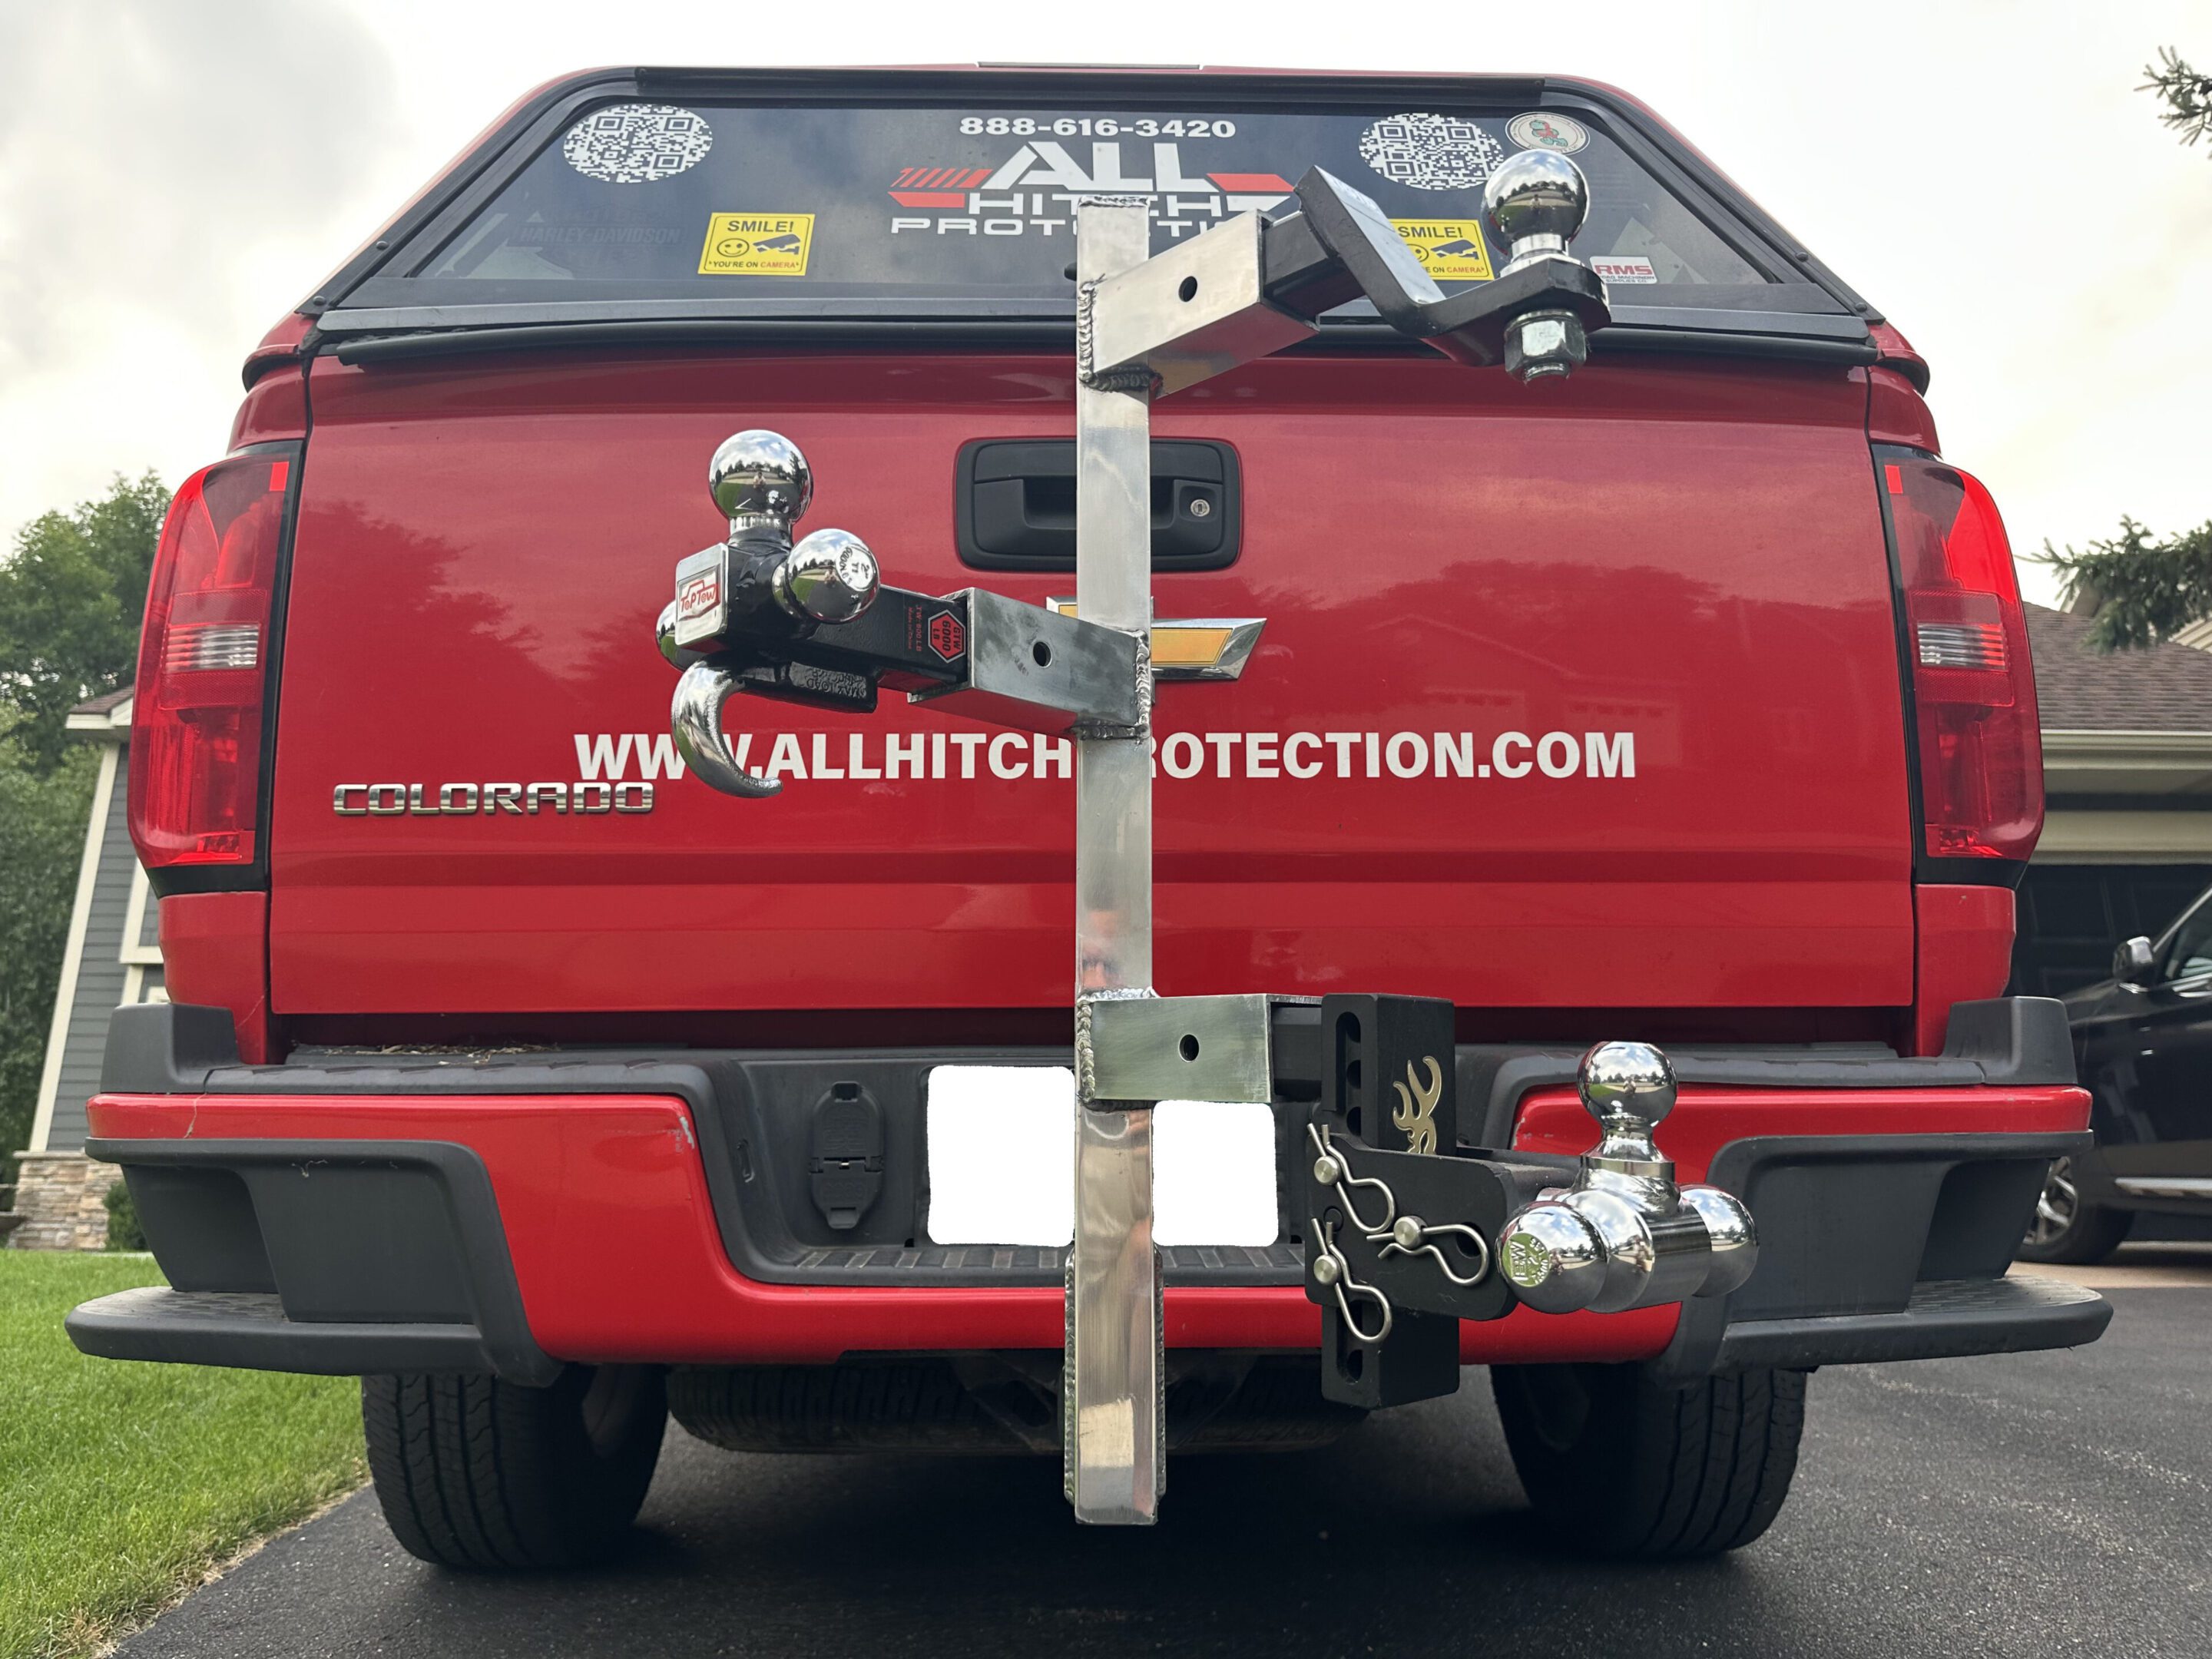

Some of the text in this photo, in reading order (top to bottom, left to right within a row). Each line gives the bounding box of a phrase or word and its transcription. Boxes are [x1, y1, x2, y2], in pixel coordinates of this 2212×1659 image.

[959, 117, 1237, 138] 888-616-3420
[980, 141, 1220, 193] ALL
[969, 192, 1223, 217] HITH
[727, 220, 795, 233] SMILE!
[1397, 226, 1463, 238] SMILE!
[1594, 264, 1653, 275] RMS
[933, 628, 940, 640] LB
[942, 620, 952, 652] 6000
[333, 782, 654, 815] COLORADO
